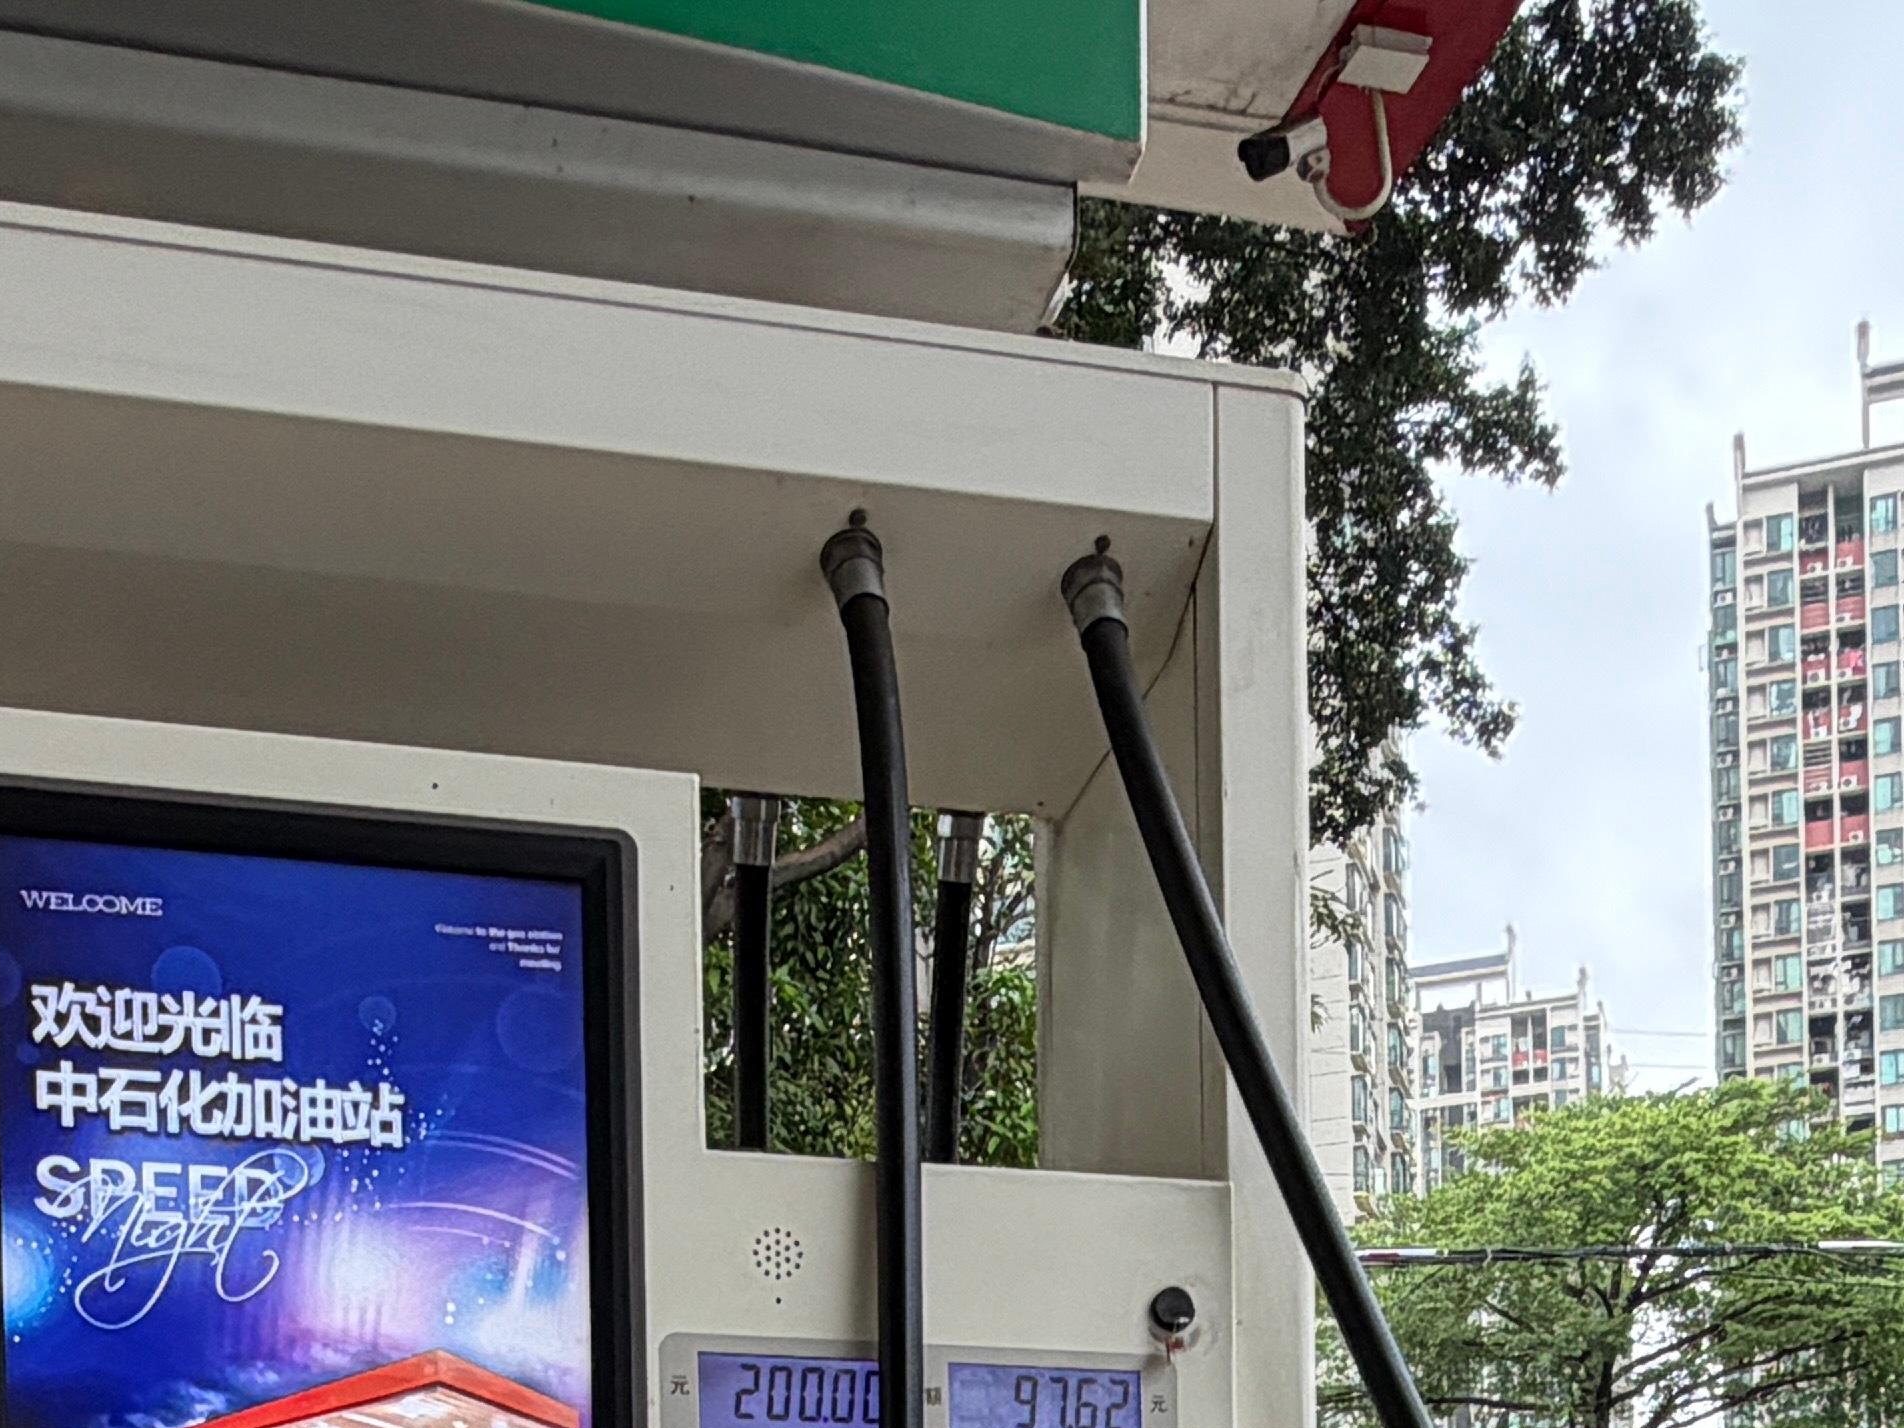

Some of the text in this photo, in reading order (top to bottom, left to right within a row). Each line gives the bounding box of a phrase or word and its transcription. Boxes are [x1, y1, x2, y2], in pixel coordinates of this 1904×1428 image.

[20, 889, 164, 917] WELCOME
[30, 981, 284, 1063] 欢迎光临
[34, 1060, 406, 1149] 中石化加油站
[34, 1154, 284, 1229] SPEED
[670, 1374, 691, 1397] 元
[734, 1363, 880, 1424] 200.00
[1150, 1394, 1168, 1414] 元
